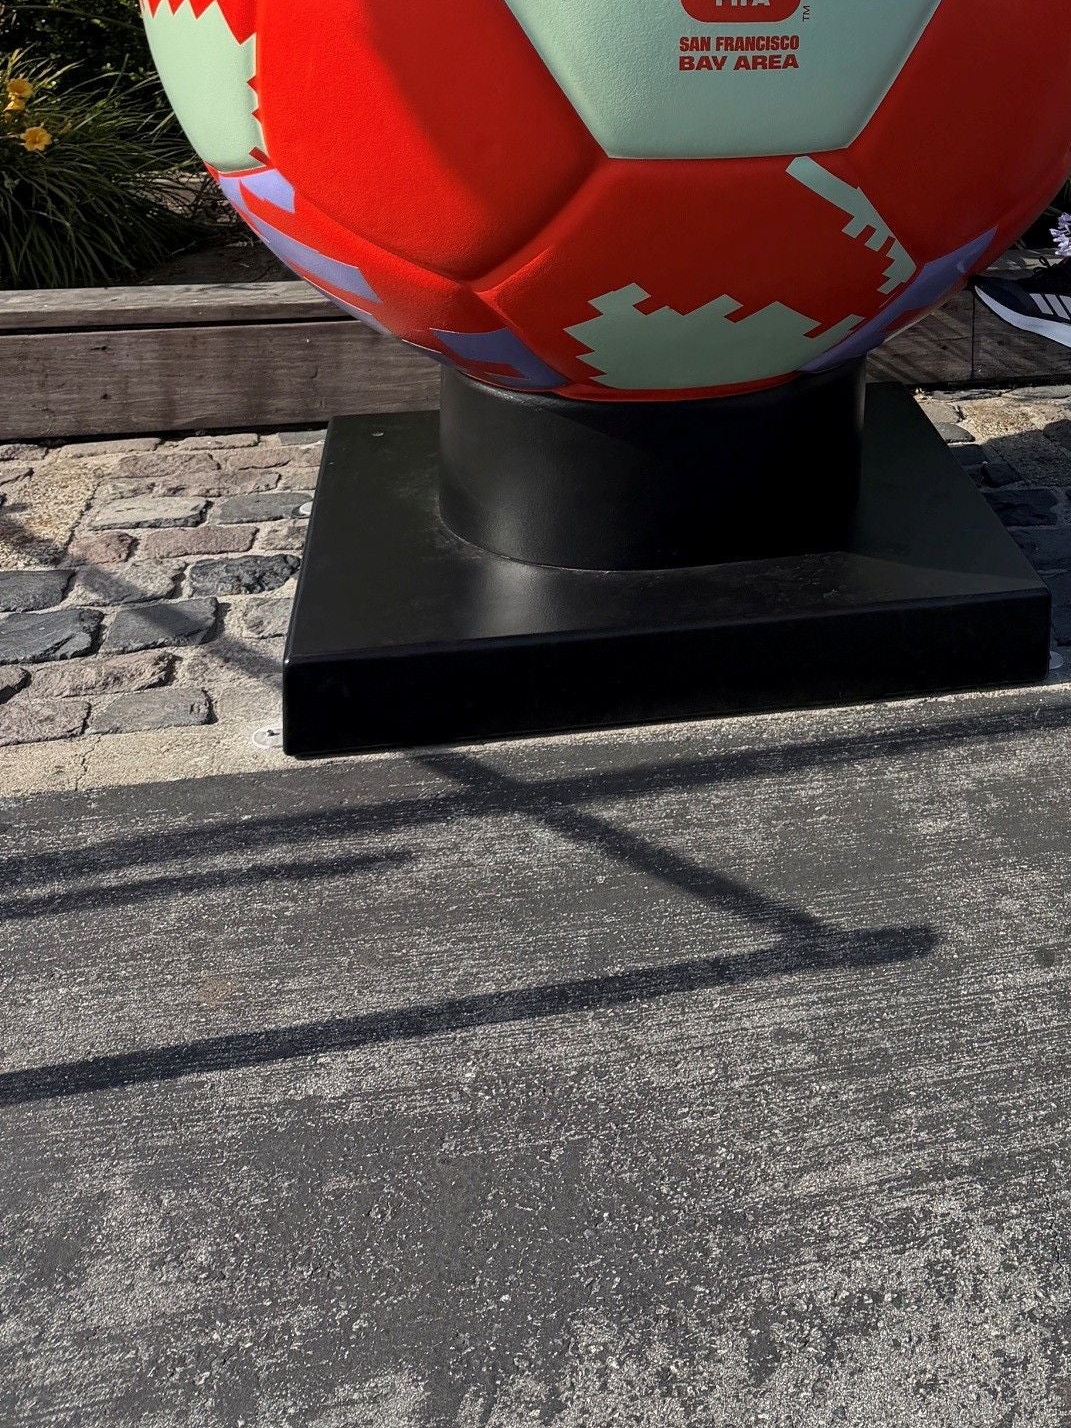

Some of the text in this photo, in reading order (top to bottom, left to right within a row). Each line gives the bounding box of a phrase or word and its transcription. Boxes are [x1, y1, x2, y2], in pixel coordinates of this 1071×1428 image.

[679, 35, 800, 52] SAN FRANCISCO
[679, 54, 799, 71] BAY AREA
